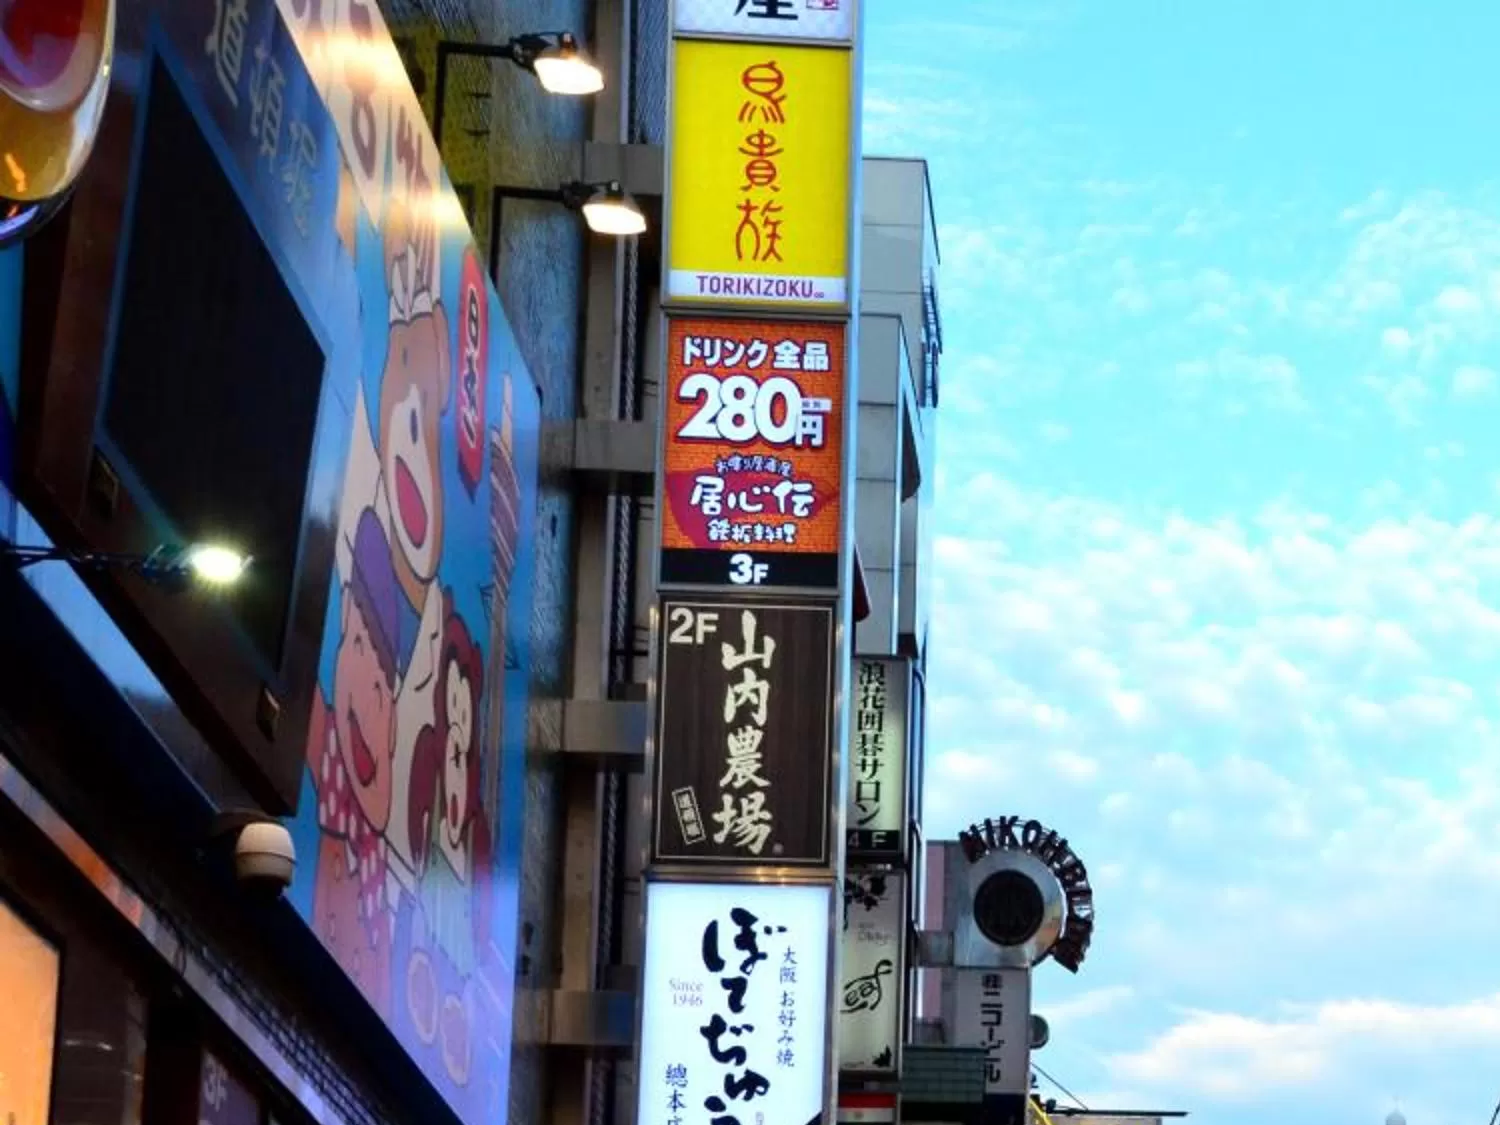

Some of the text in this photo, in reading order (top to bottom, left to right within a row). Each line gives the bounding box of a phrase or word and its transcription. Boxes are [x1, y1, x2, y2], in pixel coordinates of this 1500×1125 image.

[735, 60, 788, 263] 鳥貴族
[695, 274, 814, 300] TORIKIZOKU
[690, 476, 816, 518] 居心伝
[729, 553, 769, 584] 3F
[669, 607, 718, 644] 2F
[712, 609, 777, 856] 山内農場
[855, 661, 886, 827] 浪花囲碁サロン
